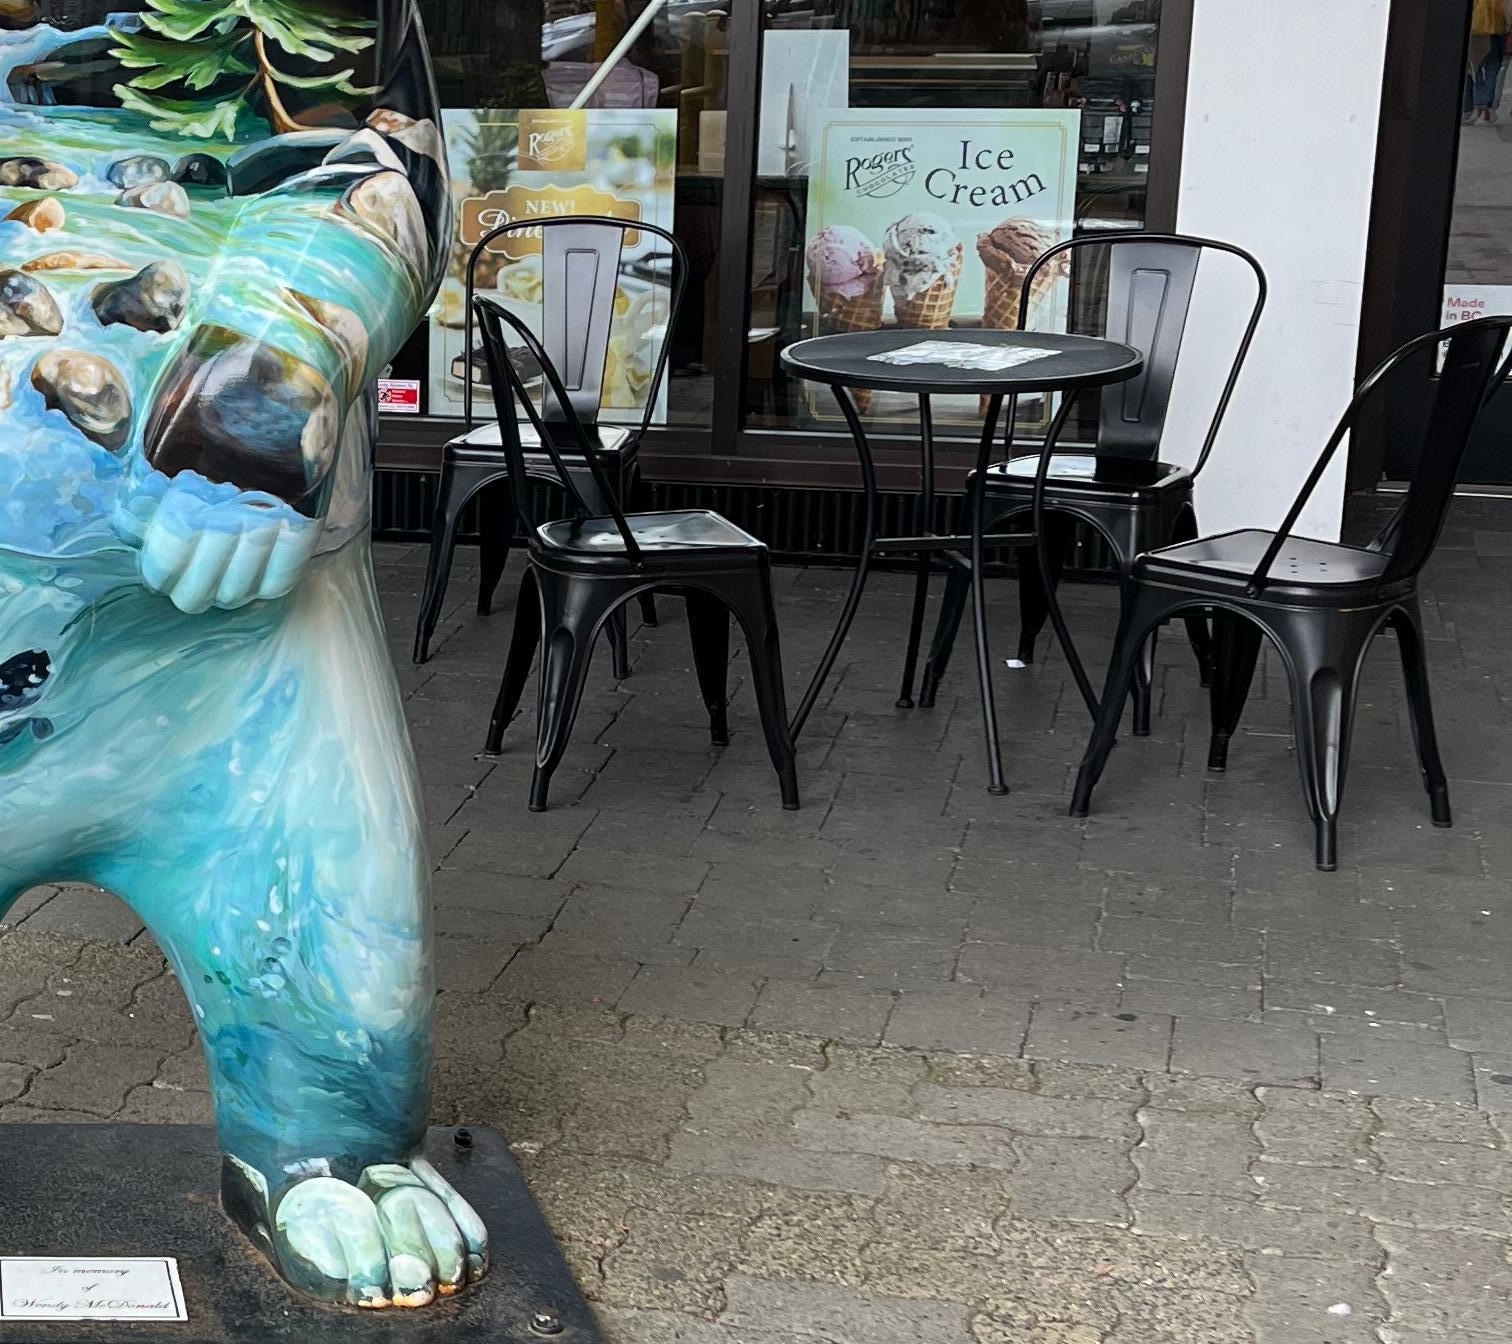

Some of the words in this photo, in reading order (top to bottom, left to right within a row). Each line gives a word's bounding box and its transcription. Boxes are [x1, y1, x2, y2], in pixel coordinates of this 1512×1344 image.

[959, 140, 1015, 170] Ice
[925, 167, 1048, 207] Cream
[525, 200, 576, 215] NEW!
[1447, 296, 1485, 308] Made
[1445, 311, 1457, 321] in
[72, 1268, 131, 1277] memory
[80, 1282, 100, 1292] of
[11, 1297, 71, 1312] Wendy
